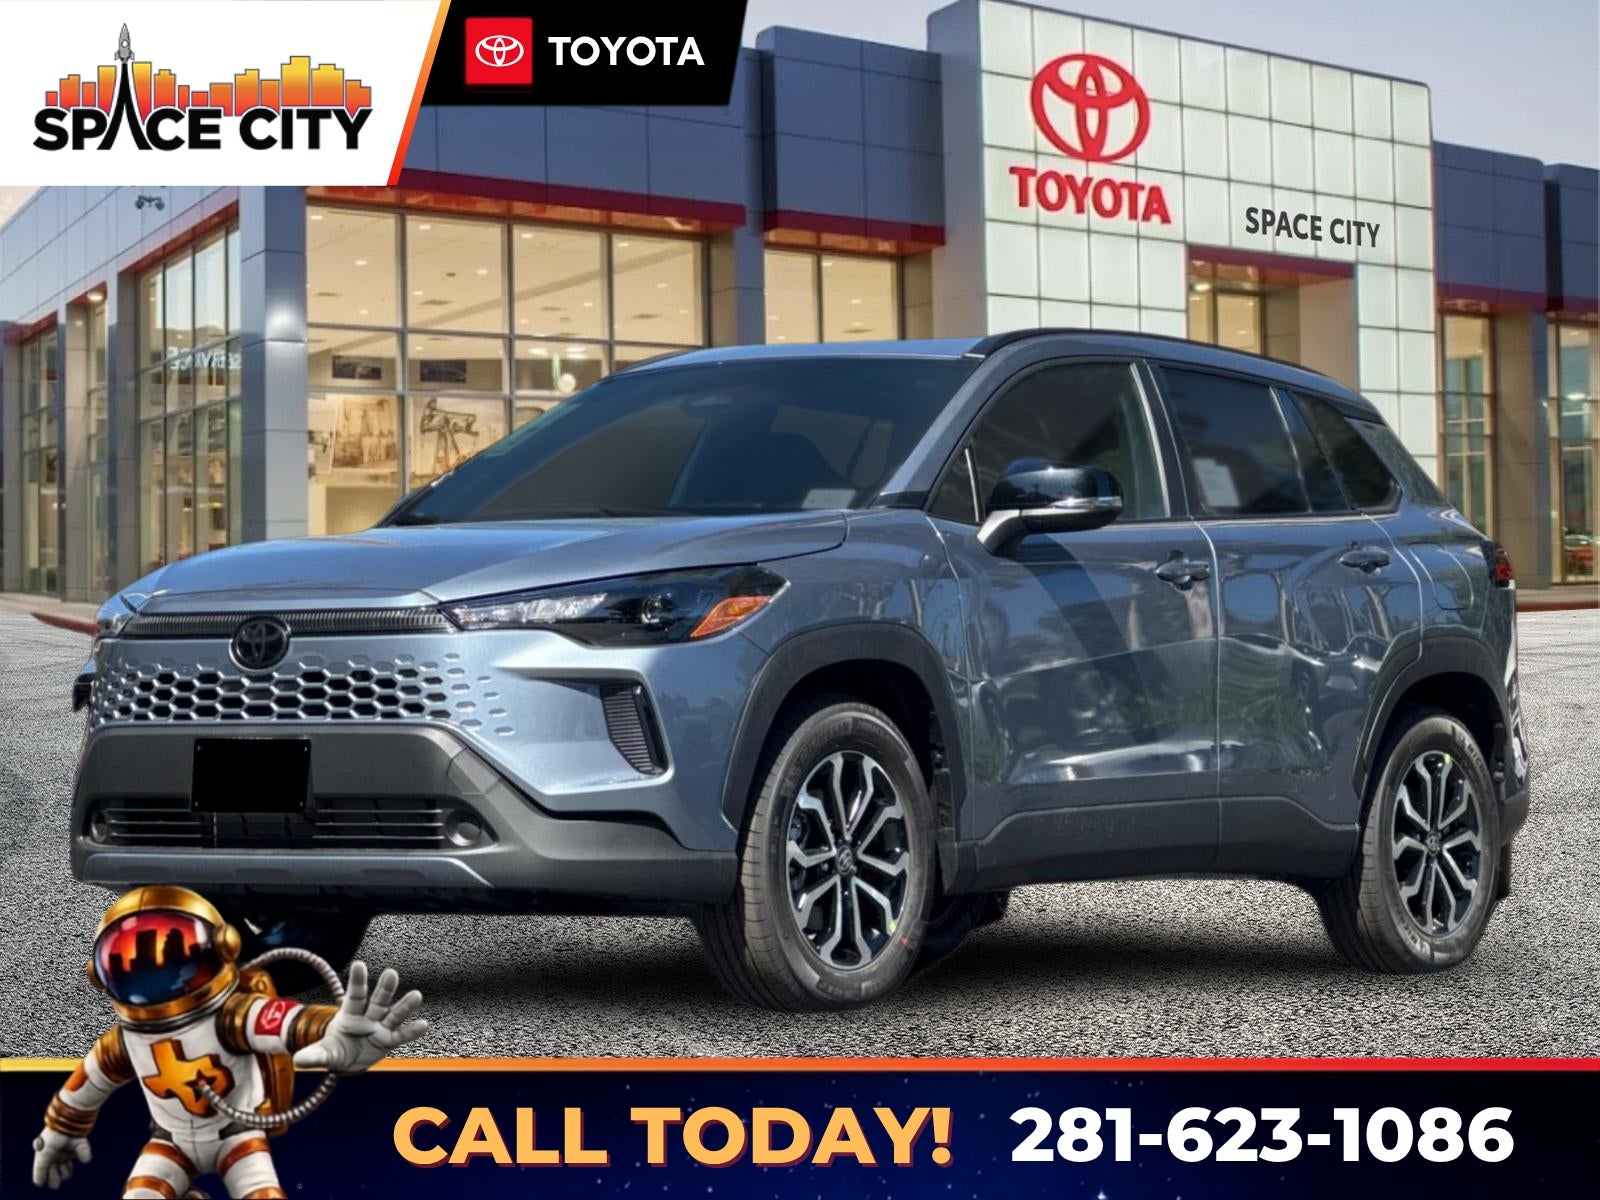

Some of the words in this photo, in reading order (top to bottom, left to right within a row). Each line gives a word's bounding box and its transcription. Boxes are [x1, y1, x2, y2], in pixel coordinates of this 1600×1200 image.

[1009, 166, 1171, 225] TOYOTA
[1245, 206, 1323, 242] SPACE
[1329, 217, 1381, 248] CITY
